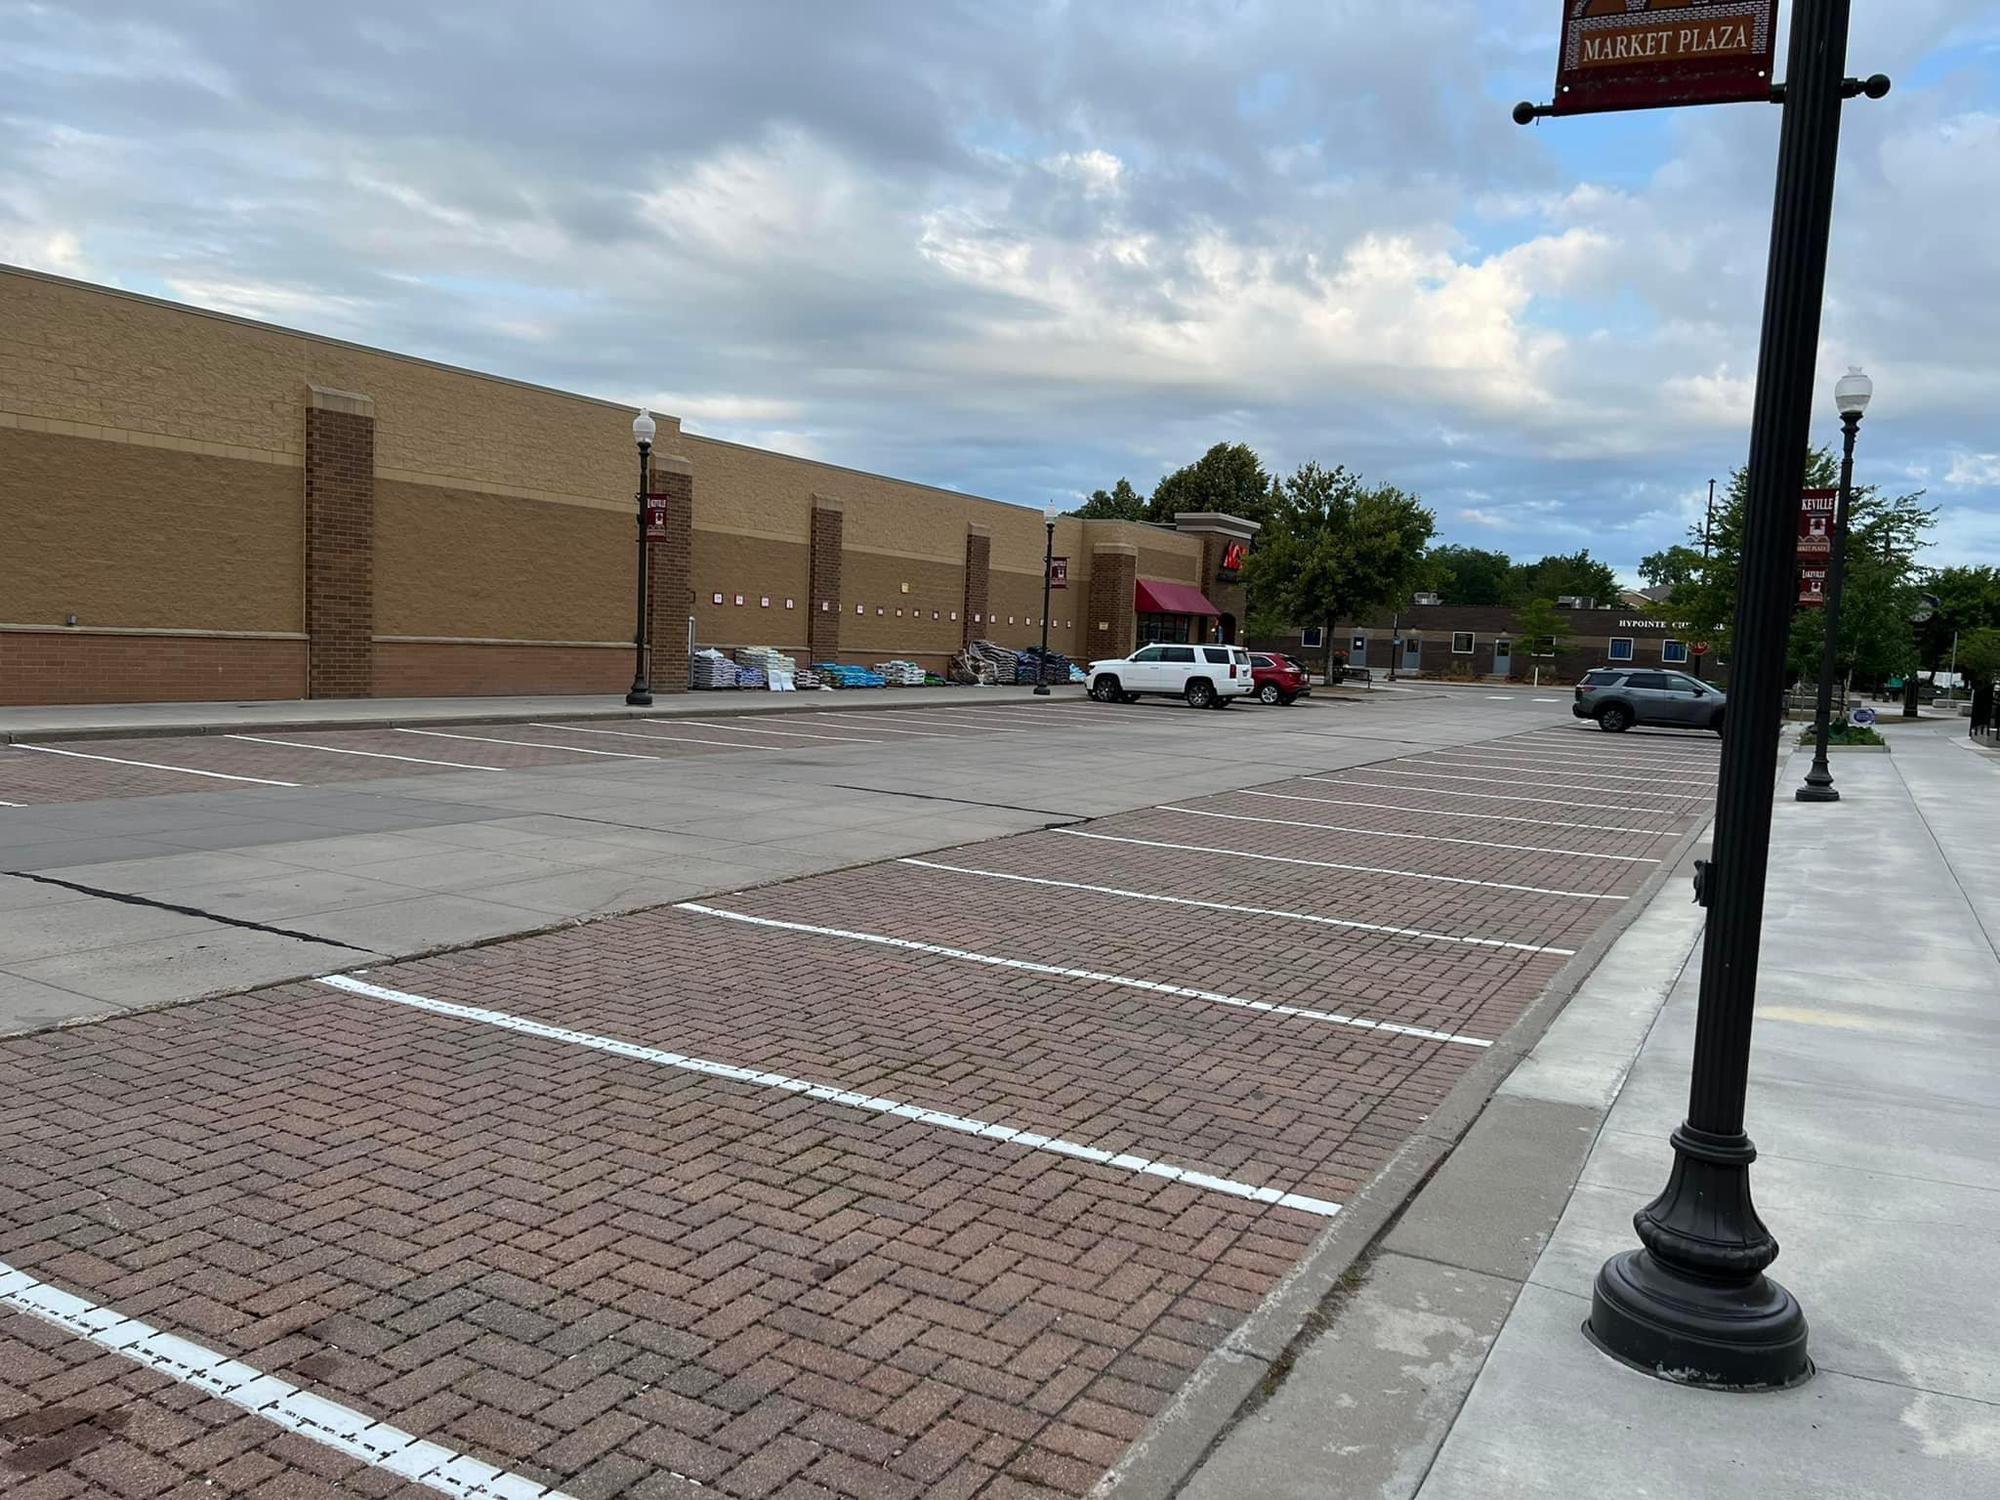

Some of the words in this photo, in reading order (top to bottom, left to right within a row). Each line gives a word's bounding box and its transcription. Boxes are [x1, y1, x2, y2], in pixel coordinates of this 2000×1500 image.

[1583, 31, 1673, 62] MARKET
[1678, 24, 1748, 53] PLAZA
[1801, 498, 1834, 511] KEVILLE
[1619, 619, 1667, 629] HYPOINTE
